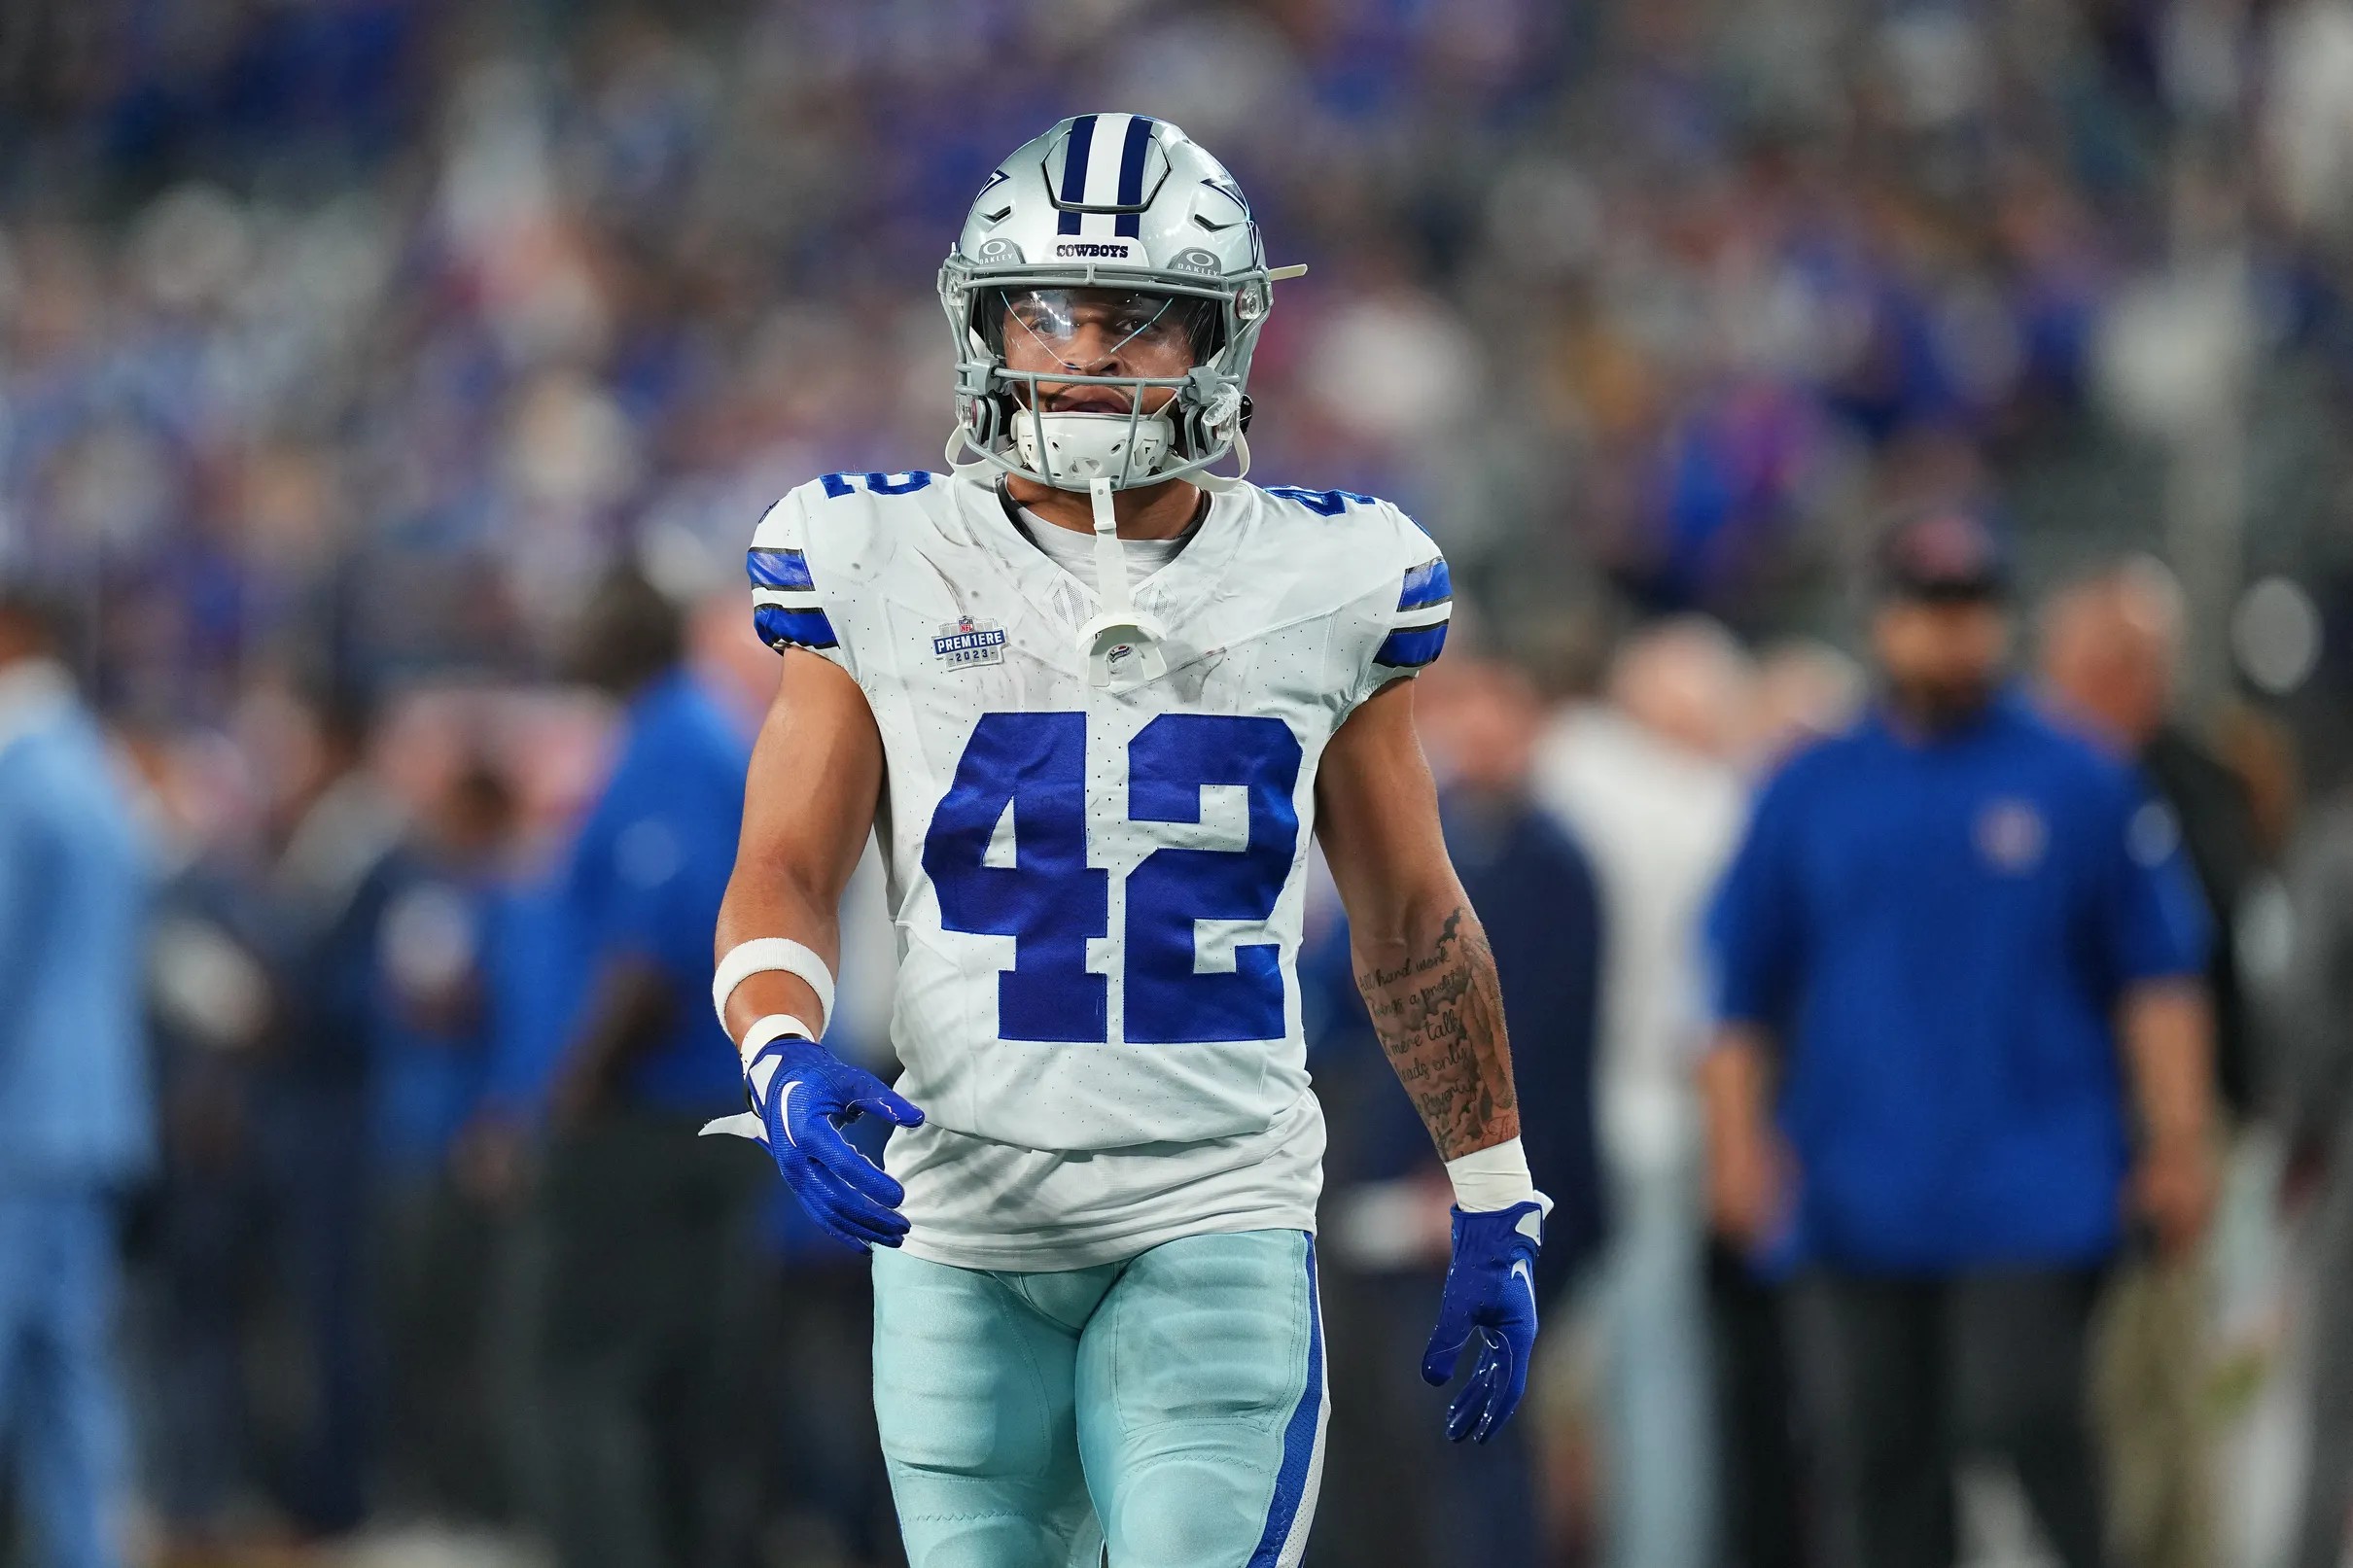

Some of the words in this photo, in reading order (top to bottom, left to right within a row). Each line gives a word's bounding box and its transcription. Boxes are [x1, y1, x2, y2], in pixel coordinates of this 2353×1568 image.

[979, 253, 1012, 264] OAKLEY
[1056, 244, 1129, 259] COWBOYS
[1177, 262, 1218, 277] OAKLEY
[960, 624, 973, 633] NFL
[922, 712, 1303, 1044] 42
[1423, 1008, 1458, 1041] talk
